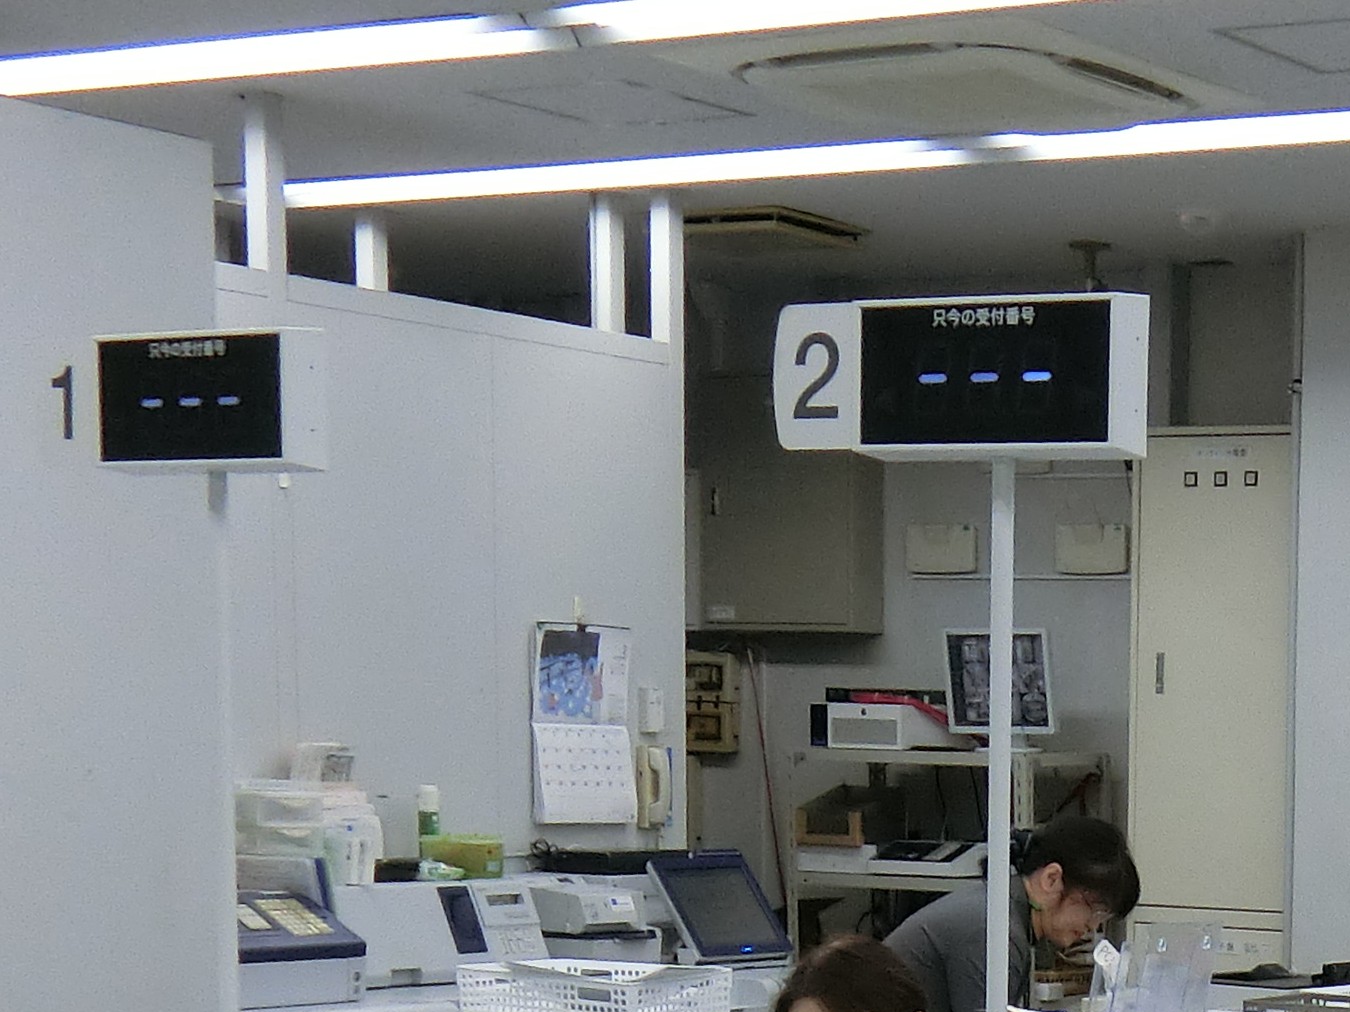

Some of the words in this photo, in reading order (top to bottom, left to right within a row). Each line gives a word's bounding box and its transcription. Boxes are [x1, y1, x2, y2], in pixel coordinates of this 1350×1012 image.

[931, 306, 1036, 327] 只今の受付番号
[51, 364, 73, 440] 1
[793, 332, 840, 420] 2
